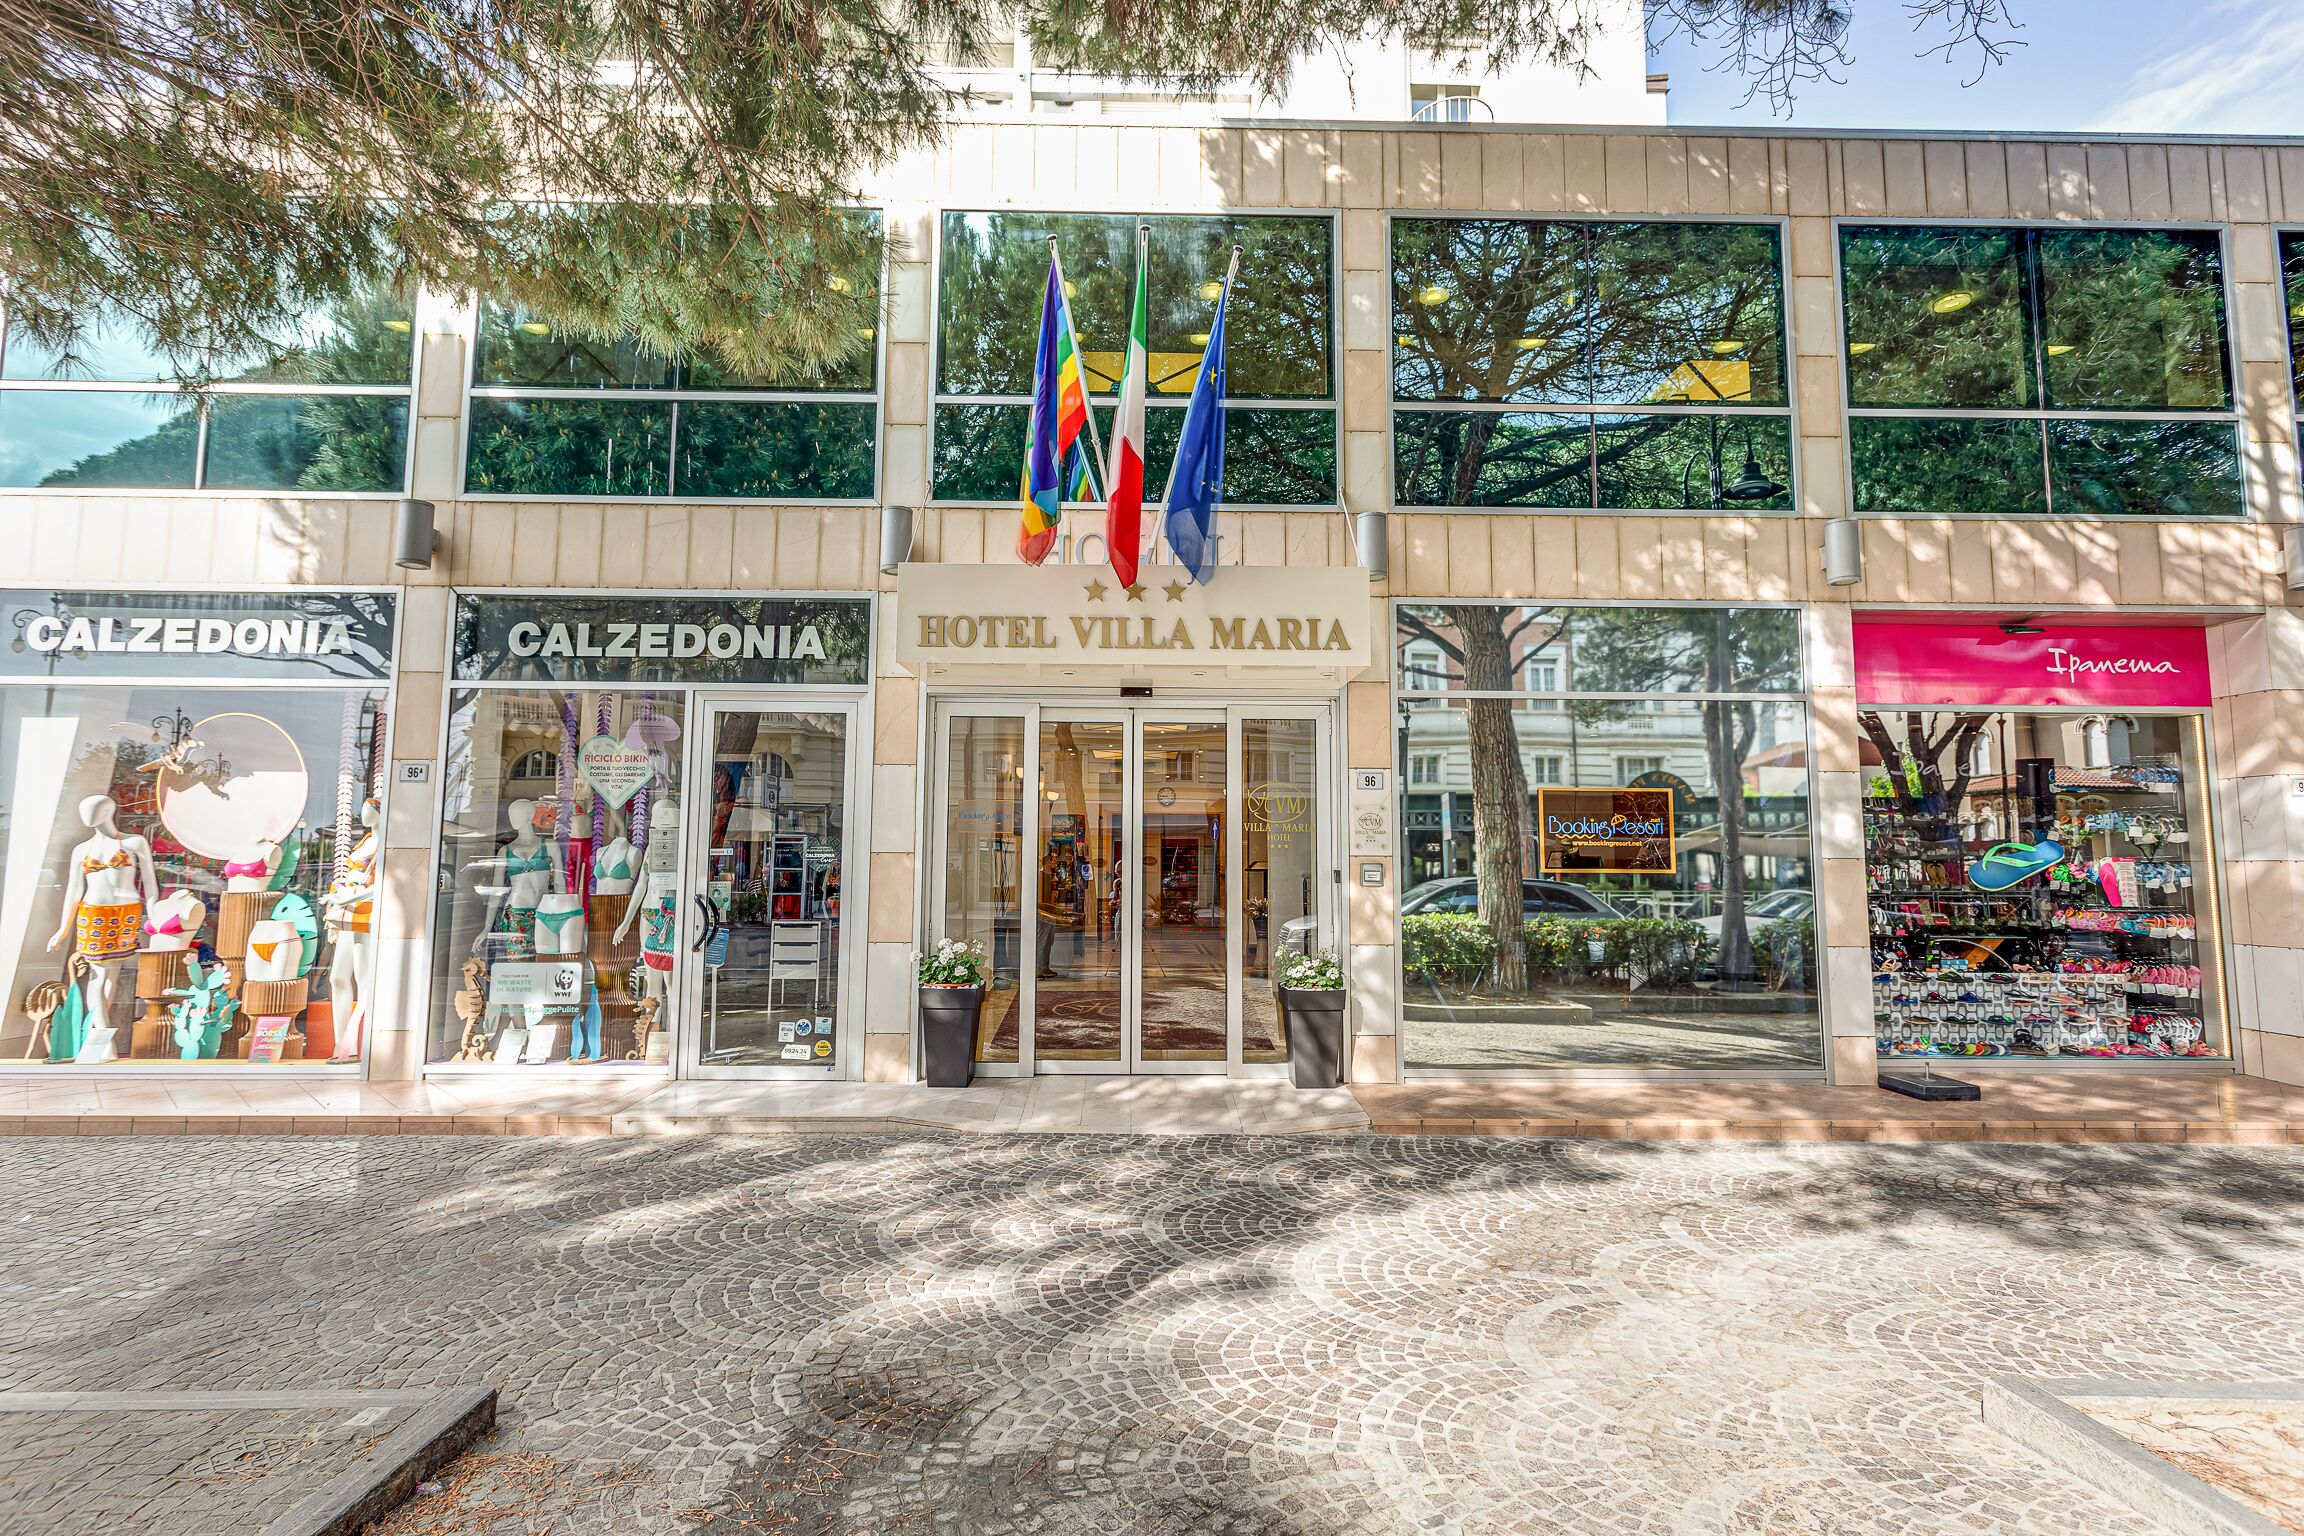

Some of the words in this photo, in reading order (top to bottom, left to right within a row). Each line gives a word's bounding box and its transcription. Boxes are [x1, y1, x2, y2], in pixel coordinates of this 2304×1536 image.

[26, 615, 355, 656] CALZEDONIA
[917, 615, 1057, 648] HOTEL
[1069, 616, 1195, 649] VILLA
[1209, 617, 1352, 651] MARIA
[507, 621, 828, 660] CALZEDONIA
[2046, 647, 2182, 684] Ipanema
[584, 754, 622, 763] RICICLO
[624, 754, 649, 763] BIKIN
[1365, 775, 1376, 787] 96
[1243, 822, 1272, 832] VILLA
[1282, 823, 1316, 833] MARIA
[1267, 833, 1292, 842] HOTEL
[1571, 839, 1643, 848] www.bookingresort.net
